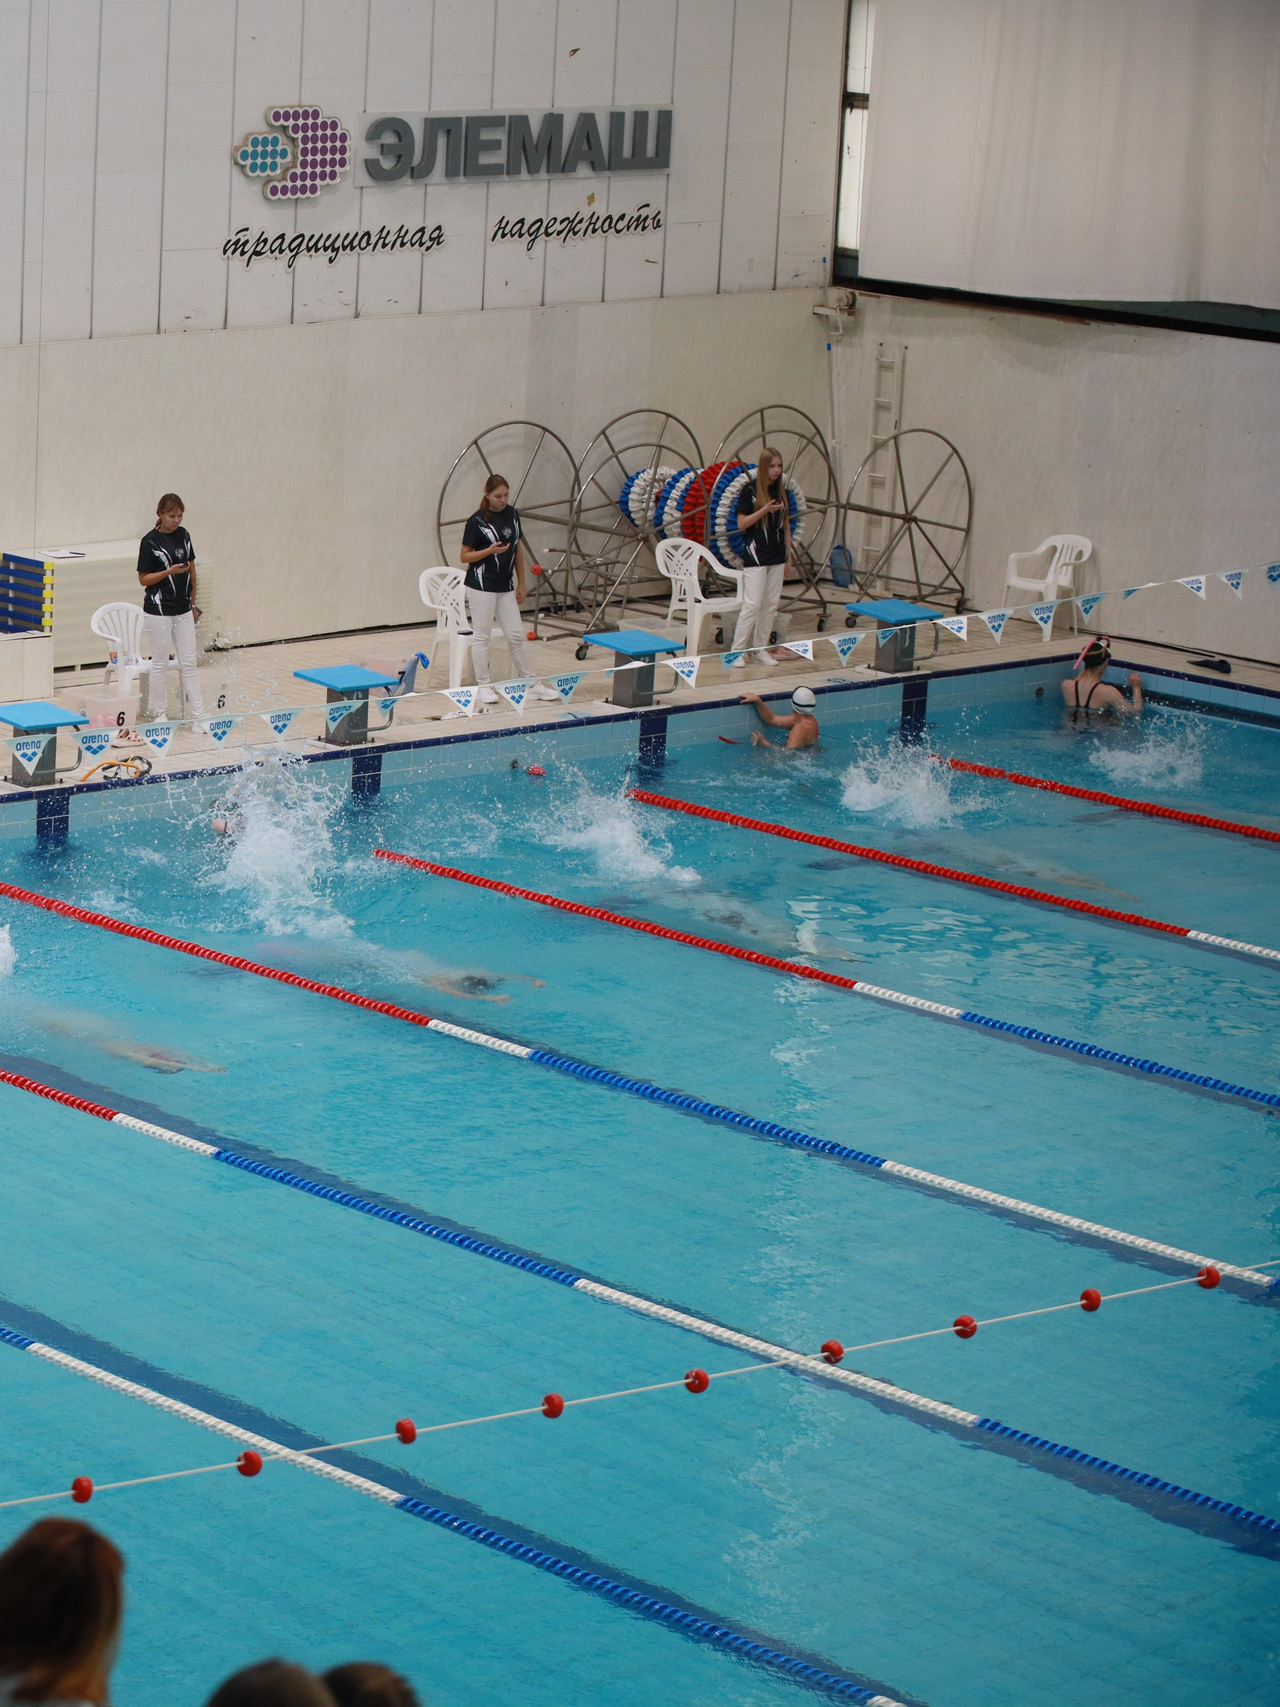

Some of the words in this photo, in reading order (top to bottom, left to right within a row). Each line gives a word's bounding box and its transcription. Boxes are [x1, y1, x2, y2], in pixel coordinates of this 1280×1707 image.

[364, 110, 673, 182] ЭЛЕМАШ
[222, 224, 445, 269] традиционная
[491, 203, 663, 252] надежность
[1034, 605, 1053, 616] arena
[557, 676, 579, 688] arena
[504, 684, 526, 695] arena
[217, 694, 226, 709] 6
[116, 711, 126, 727] 6
[270, 712, 292, 724] arena
[145, 726, 171, 738] arena
[209, 720, 233, 732] arena
[81, 733, 110, 745] arena
[15, 740, 41, 752] arena
